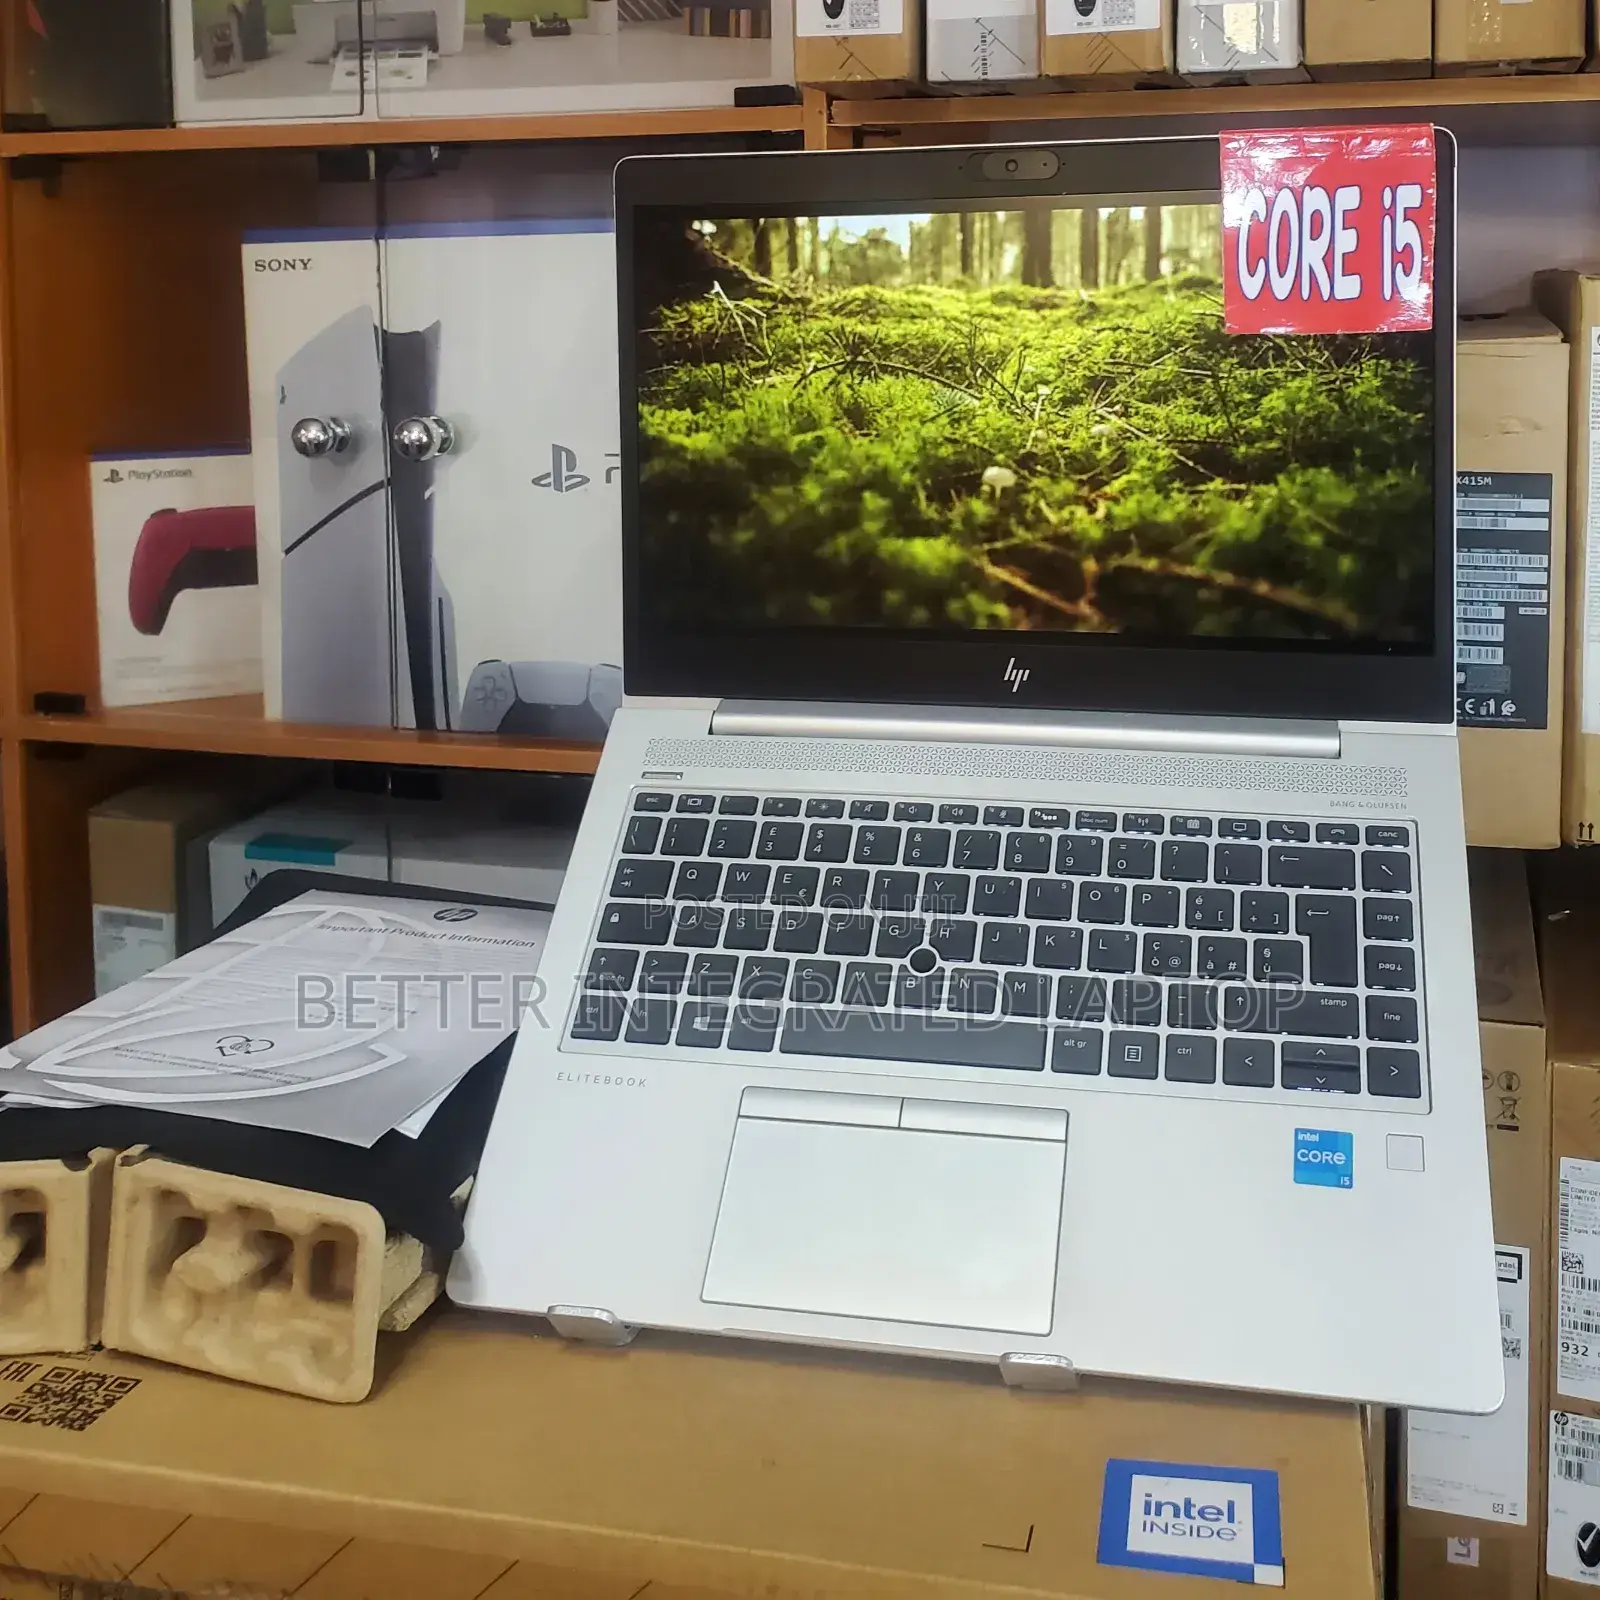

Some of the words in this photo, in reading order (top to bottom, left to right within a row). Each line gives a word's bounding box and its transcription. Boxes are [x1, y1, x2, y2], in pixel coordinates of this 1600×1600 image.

[1237, 186, 1362, 301] CORE
[1382, 184, 1423, 301] i5
[254, 258, 312, 272] SONY
[128, 468, 192, 480] PlayStation
[1456, 476, 1492, 486] X415M
[1003, 657, 1030, 693] hp
[1329, 800, 1355, 808] BANG
[1365, 801, 1407, 810] OLUFSEN
[673, 824, 677, 832] !
[770, 827, 777, 835] £
[817, 830, 823, 838] $
[866, 832, 874, 841] %
[914, 833, 922, 841] &
[671, 838, 674, 846] 1
[717, 840, 725, 848] 2
[964, 836, 972, 845] /
[1016, 838, 1020, 847] (
[1067, 840, 1072, 850] )
[765, 842, 773, 851] 3
[863, 847, 870, 855] 5
[1172, 846, 1178, 854] ?
[913, 849, 920, 857] 6
[964, 851, 970, 860] 7
[1014, 854, 1022, 863] 8
[1066, 857, 1073, 866] 9
[687, 869, 697, 879] Q
[737, 871, 750, 881] W
[783, 874, 792, 883] E
[833, 876, 842, 886] R
[883, 879, 891, 888] T
[935, 881, 943, 891] Y
[985, 884, 994, 894] U
[1143, 894, 1151, 903] P
[1196, 896, 1202, 904] é
[1195, 911, 1202, 919] è
[1218, 911, 1223, 921] [
[1274, 914, 1278, 924] ]
[316, 923, 389, 934] Important
[389, 928, 447, 940] Product
[448, 933, 536, 948] Information
[992, 932, 999, 941] J
[1046, 935, 1055, 946] K
[1100, 939, 1107, 949] L
[1264, 948, 1271, 957] §
[1152, 957, 1159, 966] ò
[1169, 957, 1181, 967] @
[1207, 960, 1213, 969] à
[1229, 962, 1236, 970] #
[1264, 963, 1272, 974] ù
[556, 1071, 648, 1088] ELITEBOOK
[1297, 1131, 1320, 1143] intel
[1561, 1341, 1589, 1357] 932
[1143, 1492, 1235, 1524] intel
